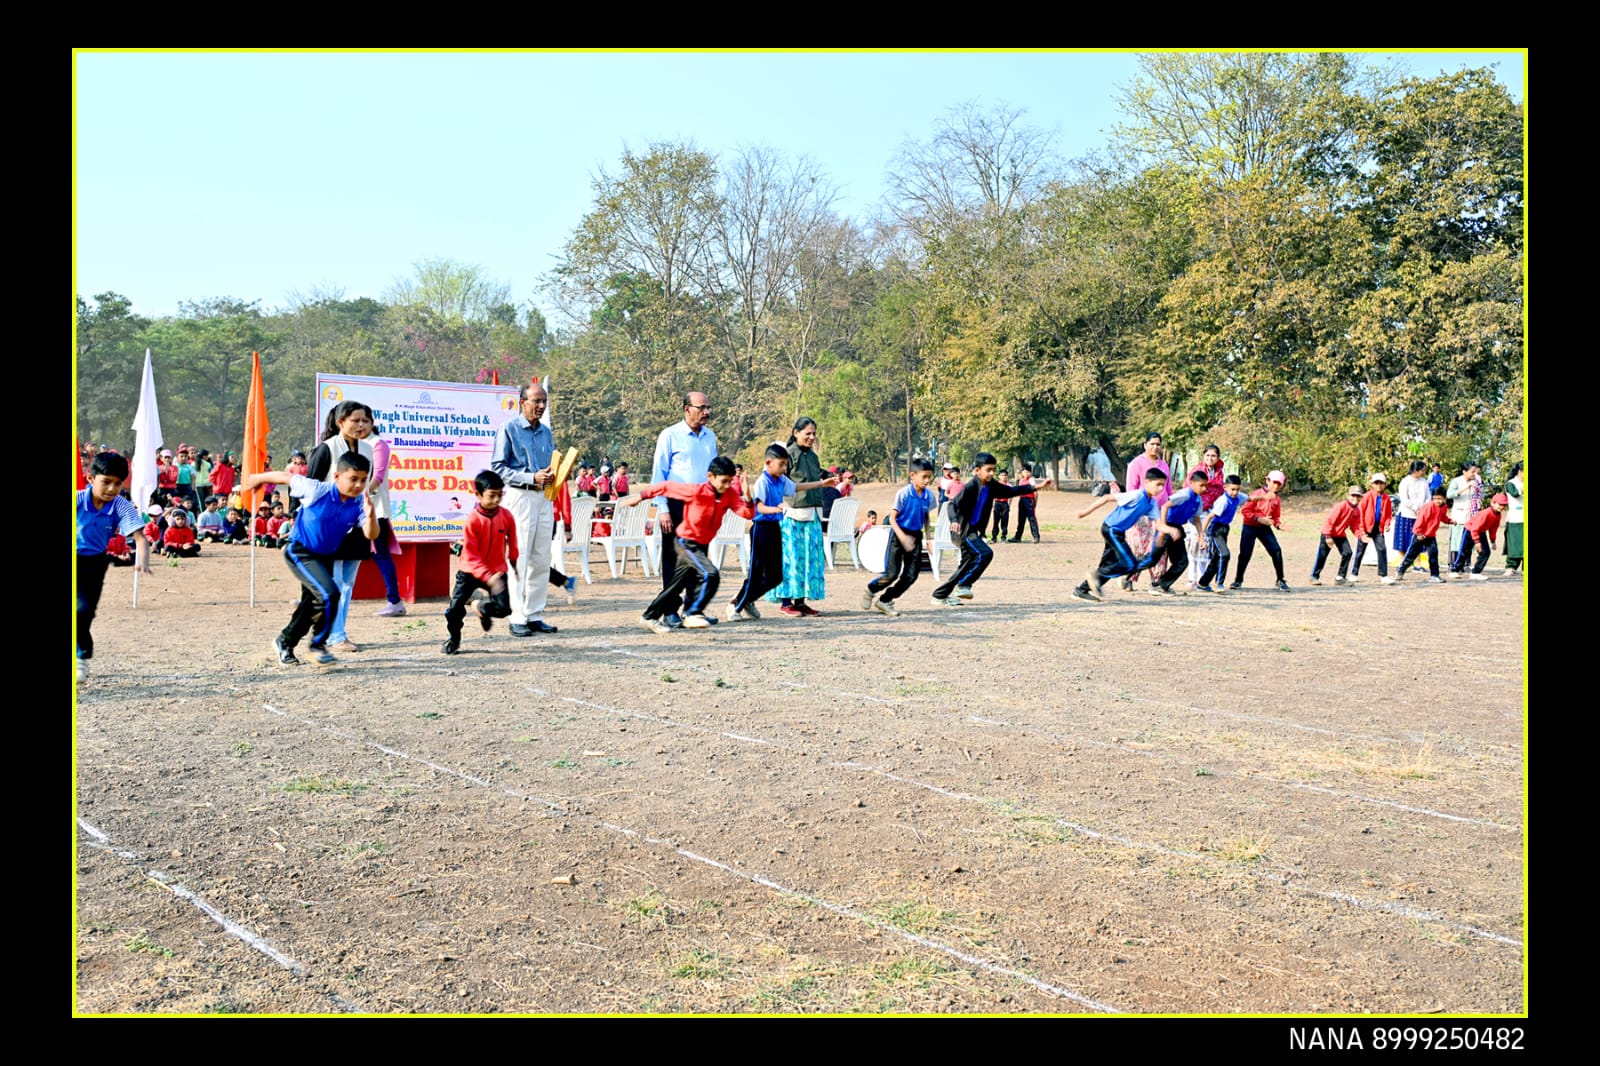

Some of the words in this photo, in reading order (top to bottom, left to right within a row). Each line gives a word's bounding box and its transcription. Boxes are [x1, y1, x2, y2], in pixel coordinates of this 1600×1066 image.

[373, 409, 400, 424] Wagh
[403, 411, 448, 423] Universal
[451, 413, 481, 424] School
[482, 415, 490, 425] &
[389, 424, 443, 436] Prathamik
[394, 437, 455, 449] Bhausahebnagar
[388, 454, 464, 471] Annual
